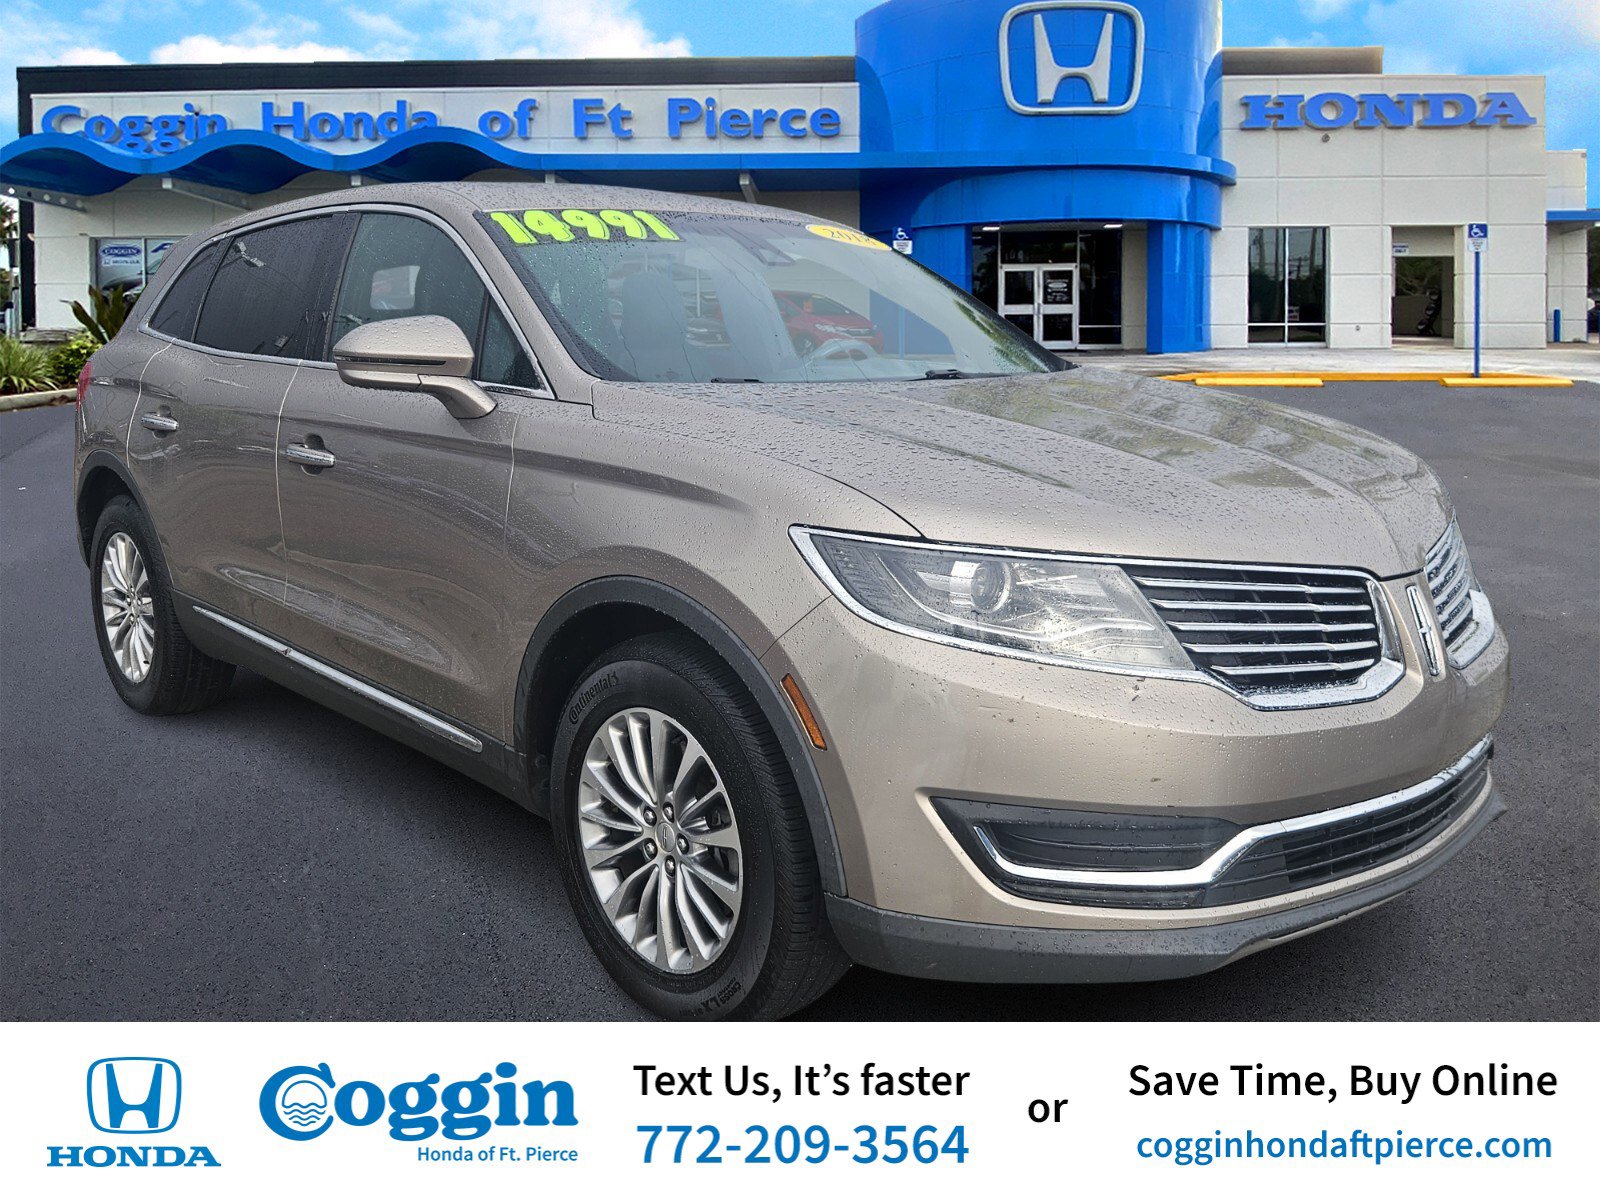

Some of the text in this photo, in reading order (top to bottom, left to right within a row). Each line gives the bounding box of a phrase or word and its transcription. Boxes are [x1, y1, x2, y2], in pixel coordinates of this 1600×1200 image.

[41, 96, 841, 154] Coggin Honda of Ft Pierce
[1240, 92, 1537, 130] HONDA
[490, 209, 682, 245] 14991
[569, 673, 613, 725] Continental
